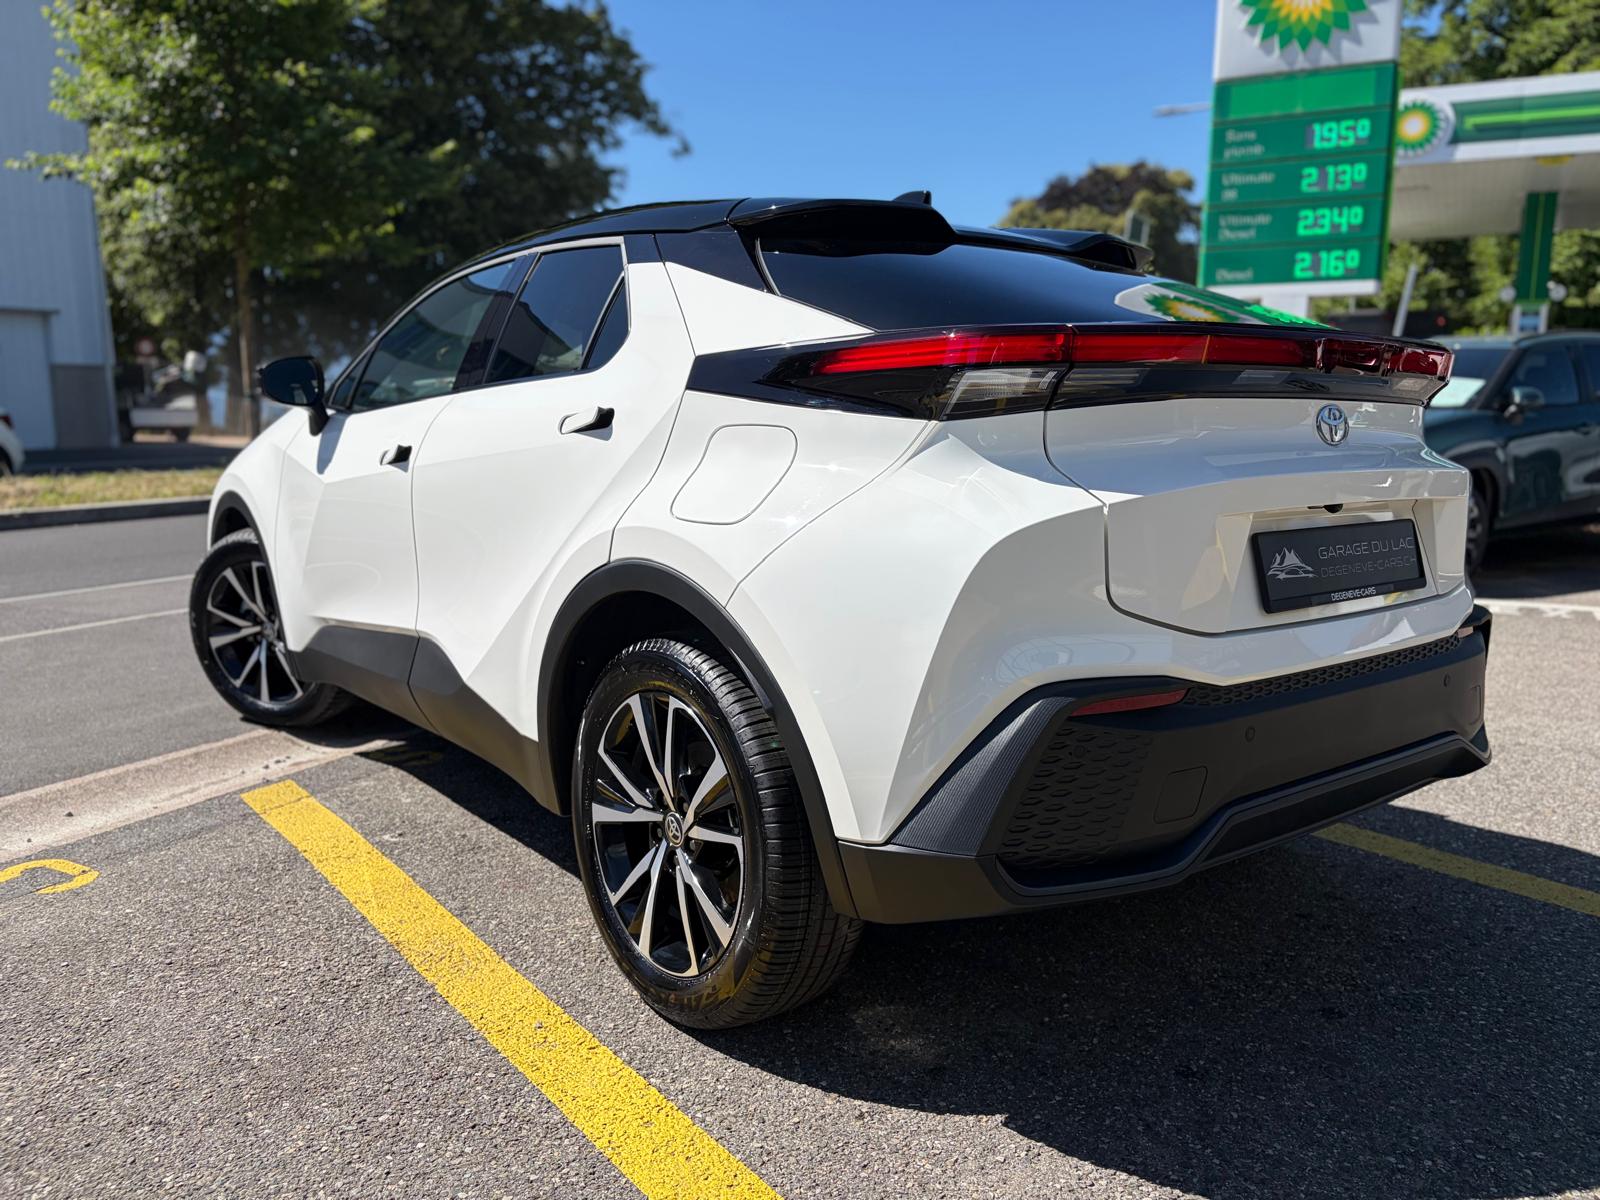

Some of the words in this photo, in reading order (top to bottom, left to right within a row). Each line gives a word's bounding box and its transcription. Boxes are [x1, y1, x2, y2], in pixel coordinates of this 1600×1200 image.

[1318, 542, 1370, 559] GARAGE
[1371, 540, 1389, 553] DU
[1391, 537, 1415, 551] LAC
[1331, 586, 1377, 601] DEGENEVE-CARS
